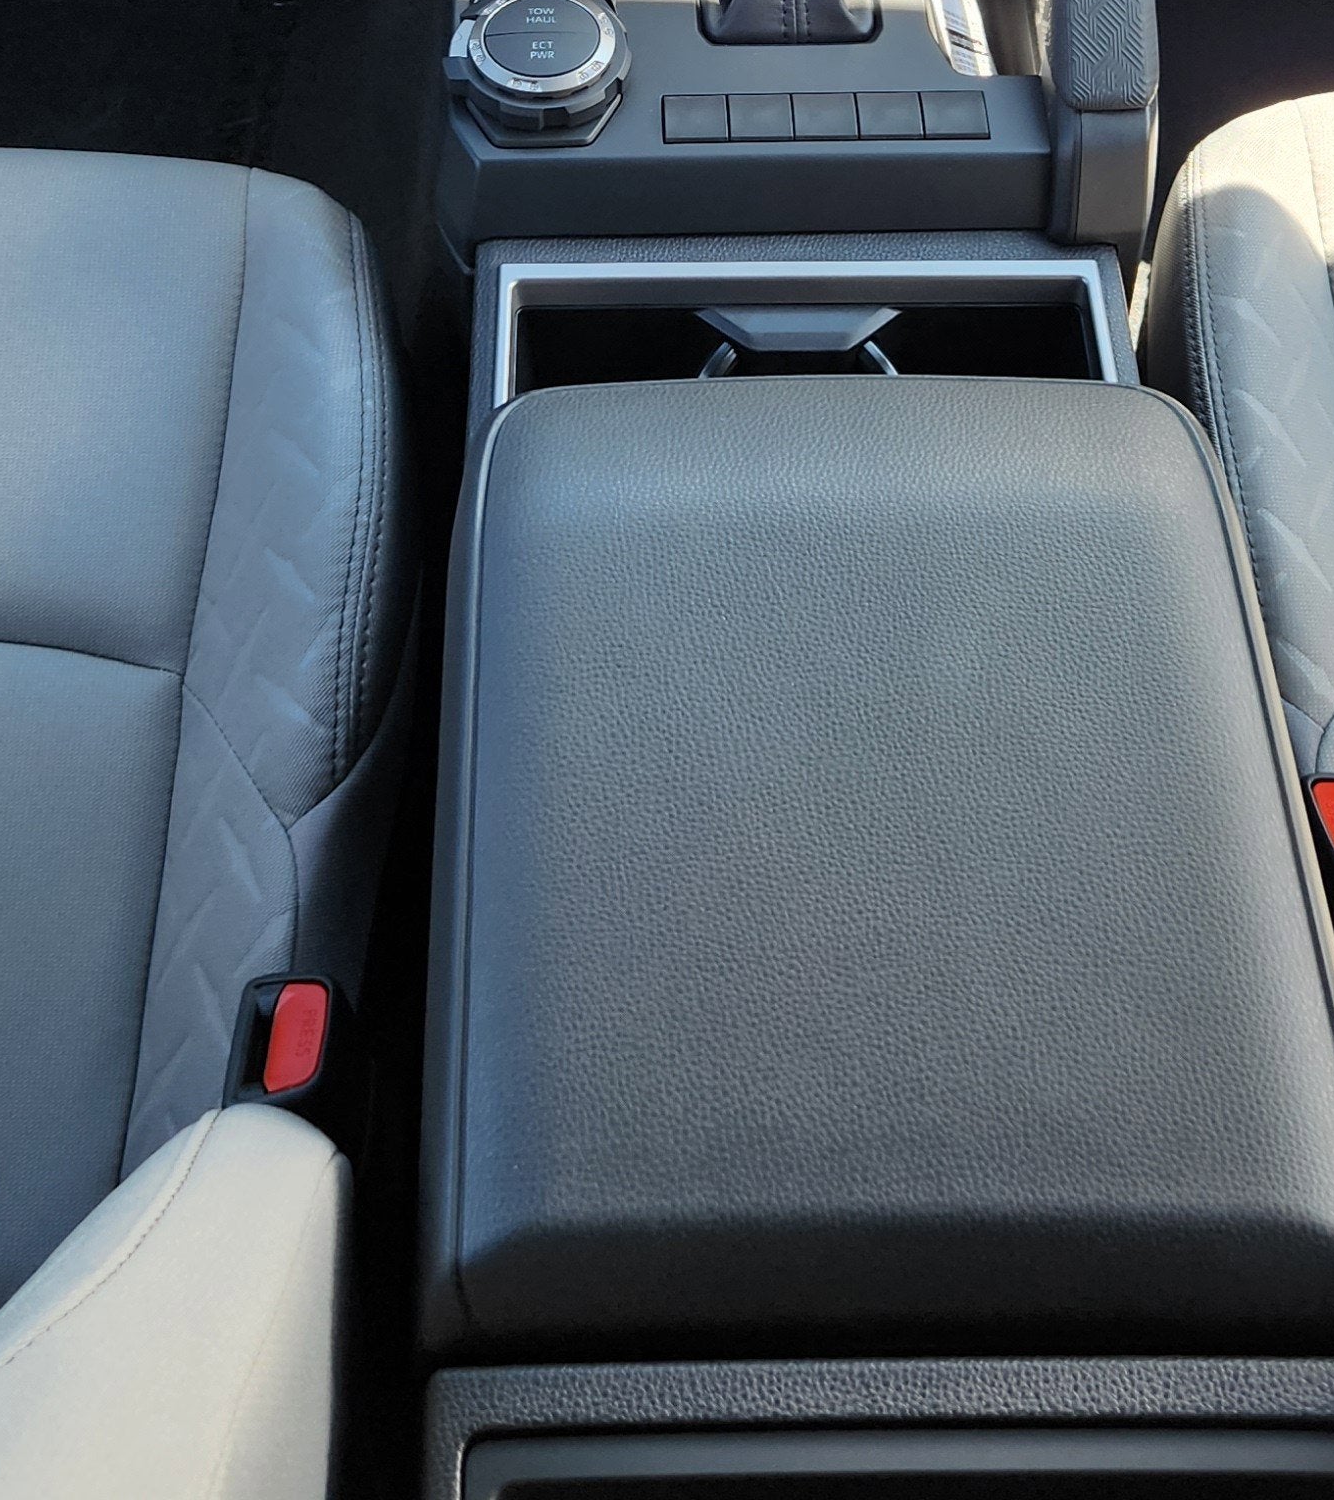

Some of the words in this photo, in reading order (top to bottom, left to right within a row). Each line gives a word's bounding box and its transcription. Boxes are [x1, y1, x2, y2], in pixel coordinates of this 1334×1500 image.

[527, 7, 555, 16] TOW
[526, 16, 557, 24] HAUL
[532, 41, 553, 50] ECT
[530, 50, 556, 60] PWR
